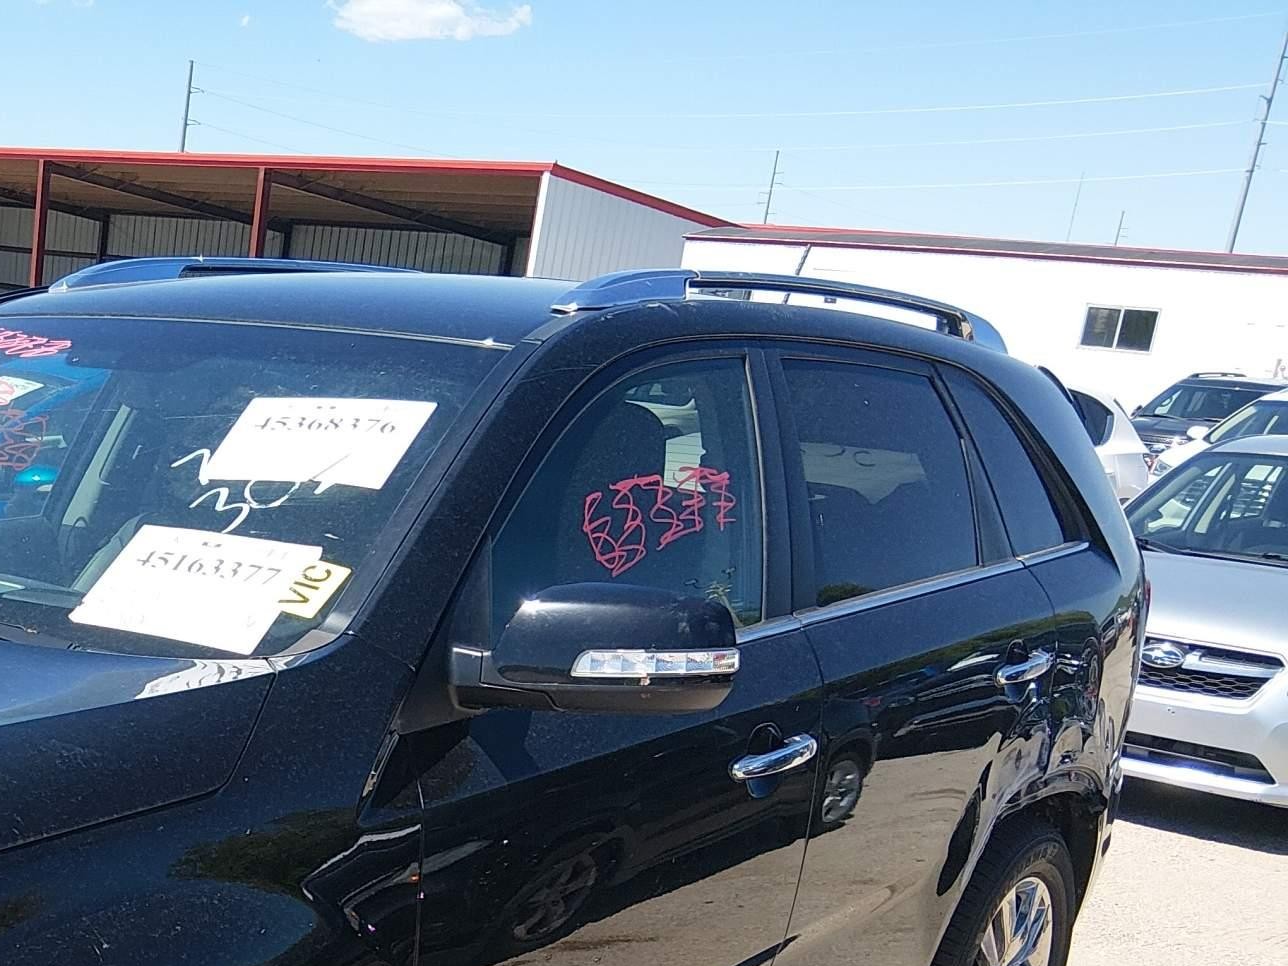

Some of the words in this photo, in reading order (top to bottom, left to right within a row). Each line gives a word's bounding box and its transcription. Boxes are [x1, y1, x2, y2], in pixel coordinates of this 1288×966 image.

[255, 416, 396, 434] 45368376
[136, 550, 283, 585] 45163377
[277, 564, 332, 604] VIC
